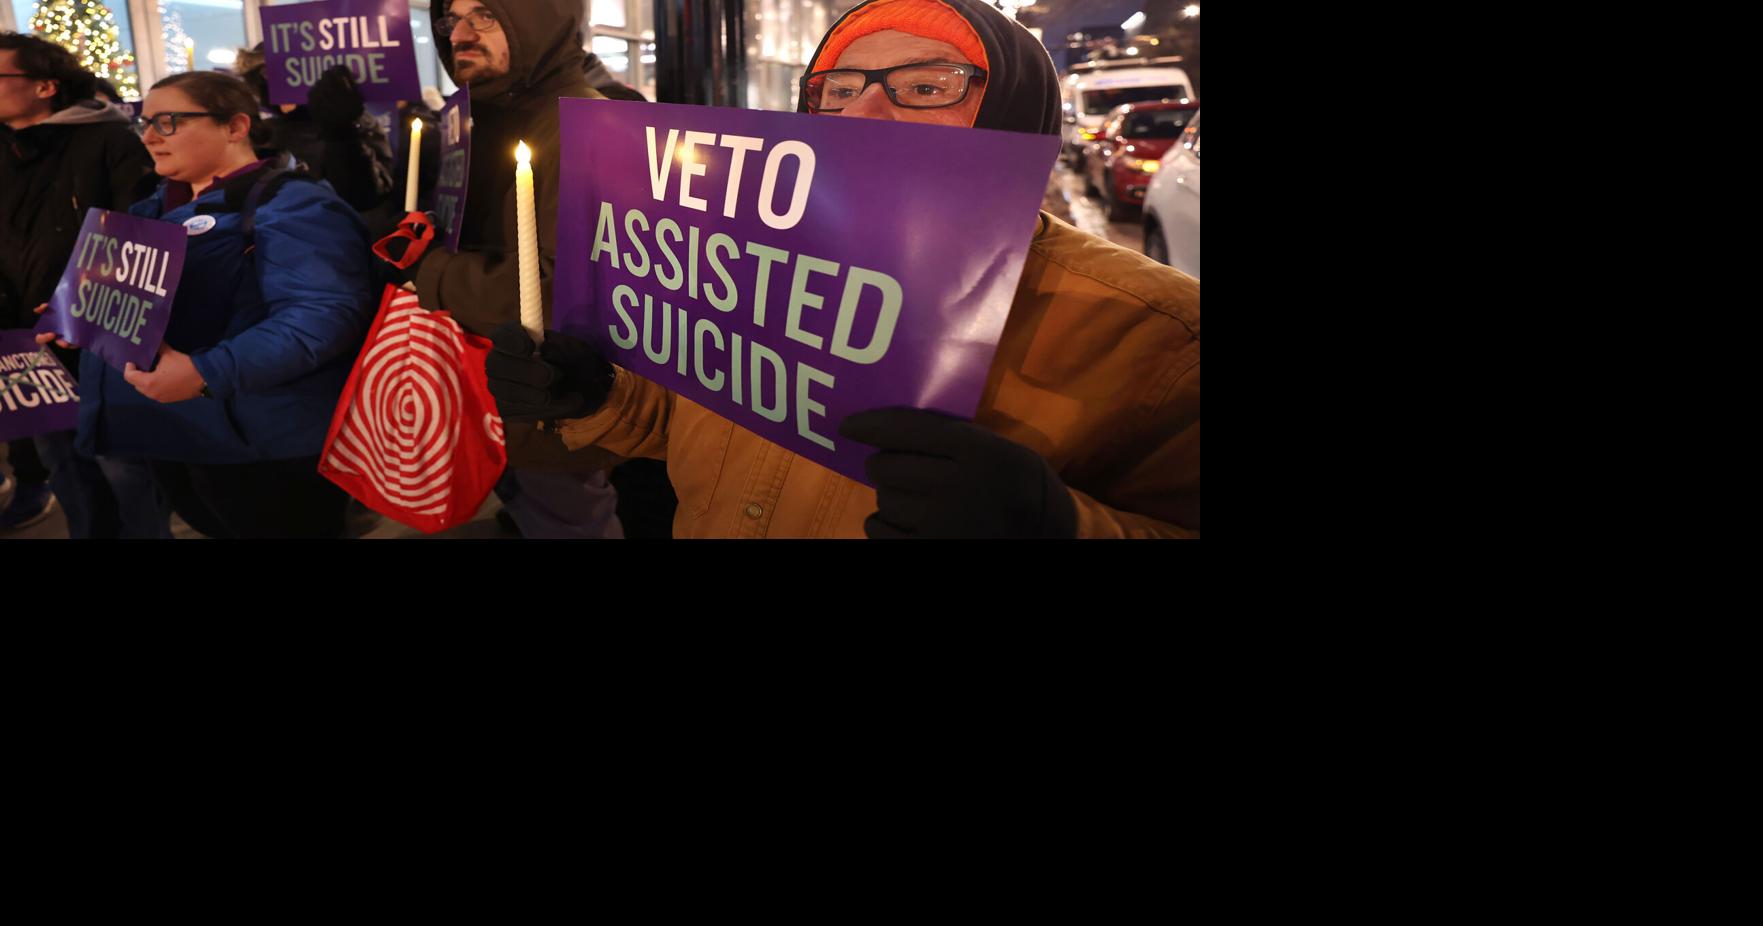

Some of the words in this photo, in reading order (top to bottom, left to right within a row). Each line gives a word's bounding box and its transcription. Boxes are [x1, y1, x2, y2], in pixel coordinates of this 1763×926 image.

[270, 21, 315, 53] IT'S
[319, 15, 400, 50] STILL
[645, 126, 816, 231] VETO
[76, 232, 118, 277] IT'S
[115, 241, 170, 297] STILL
[590, 201, 903, 365] ASSISTED
[71, 279, 153, 345] SUICIDE
[0, 369, 80, 412] ICIDE
[608, 285, 835, 452] SUICIDE
